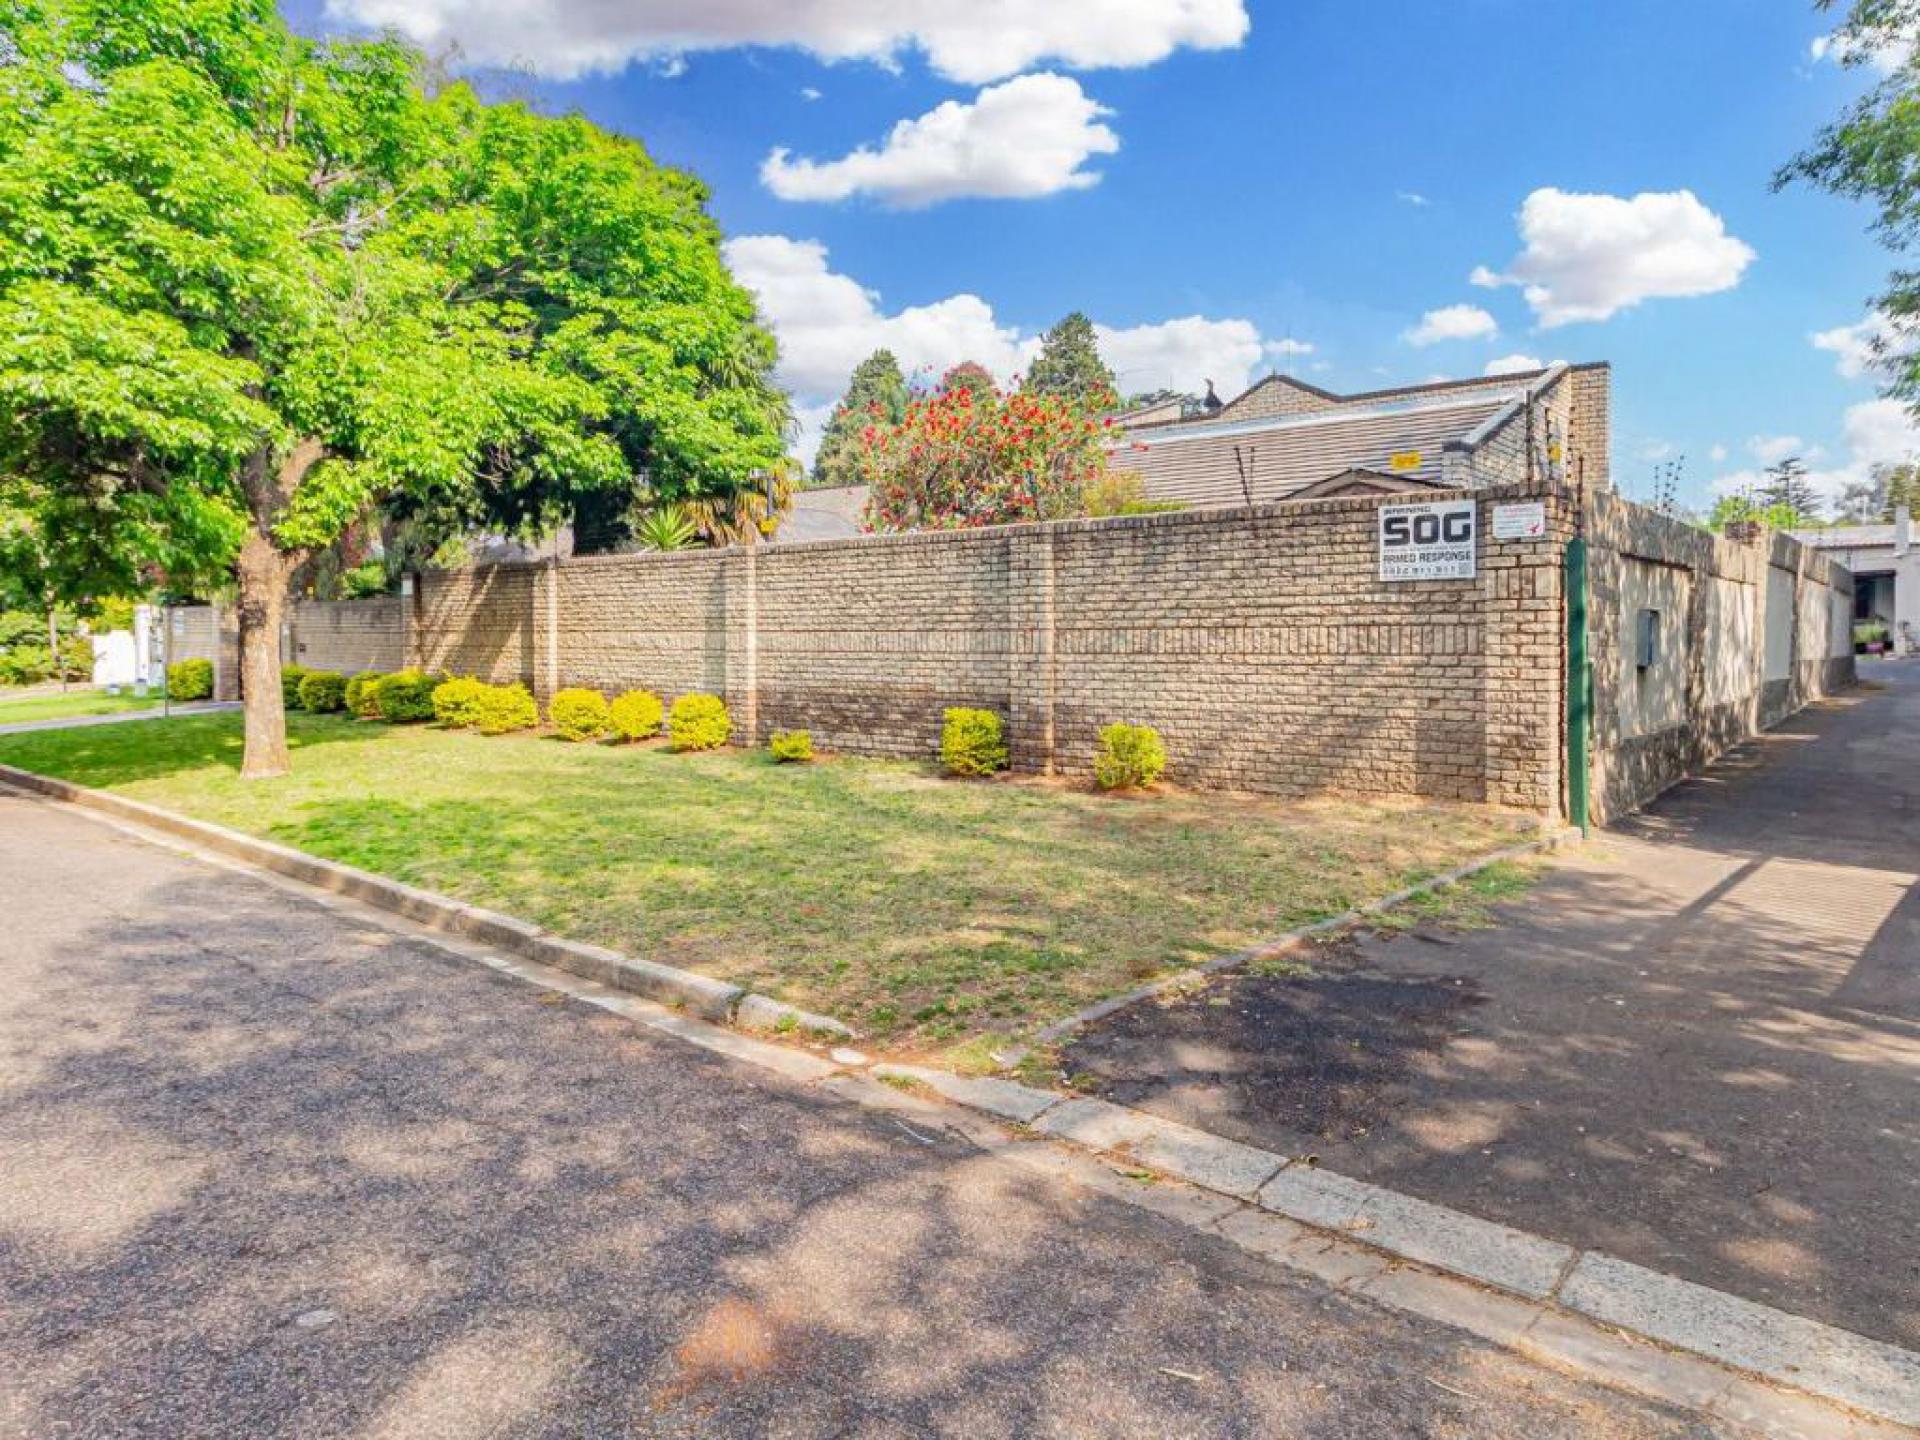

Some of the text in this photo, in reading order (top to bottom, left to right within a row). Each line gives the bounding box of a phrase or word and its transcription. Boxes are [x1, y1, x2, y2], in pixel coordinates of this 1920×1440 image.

[1384, 512, 1471, 546] SOG
[1384, 551, 1471, 564] ARMED RESPONSE
